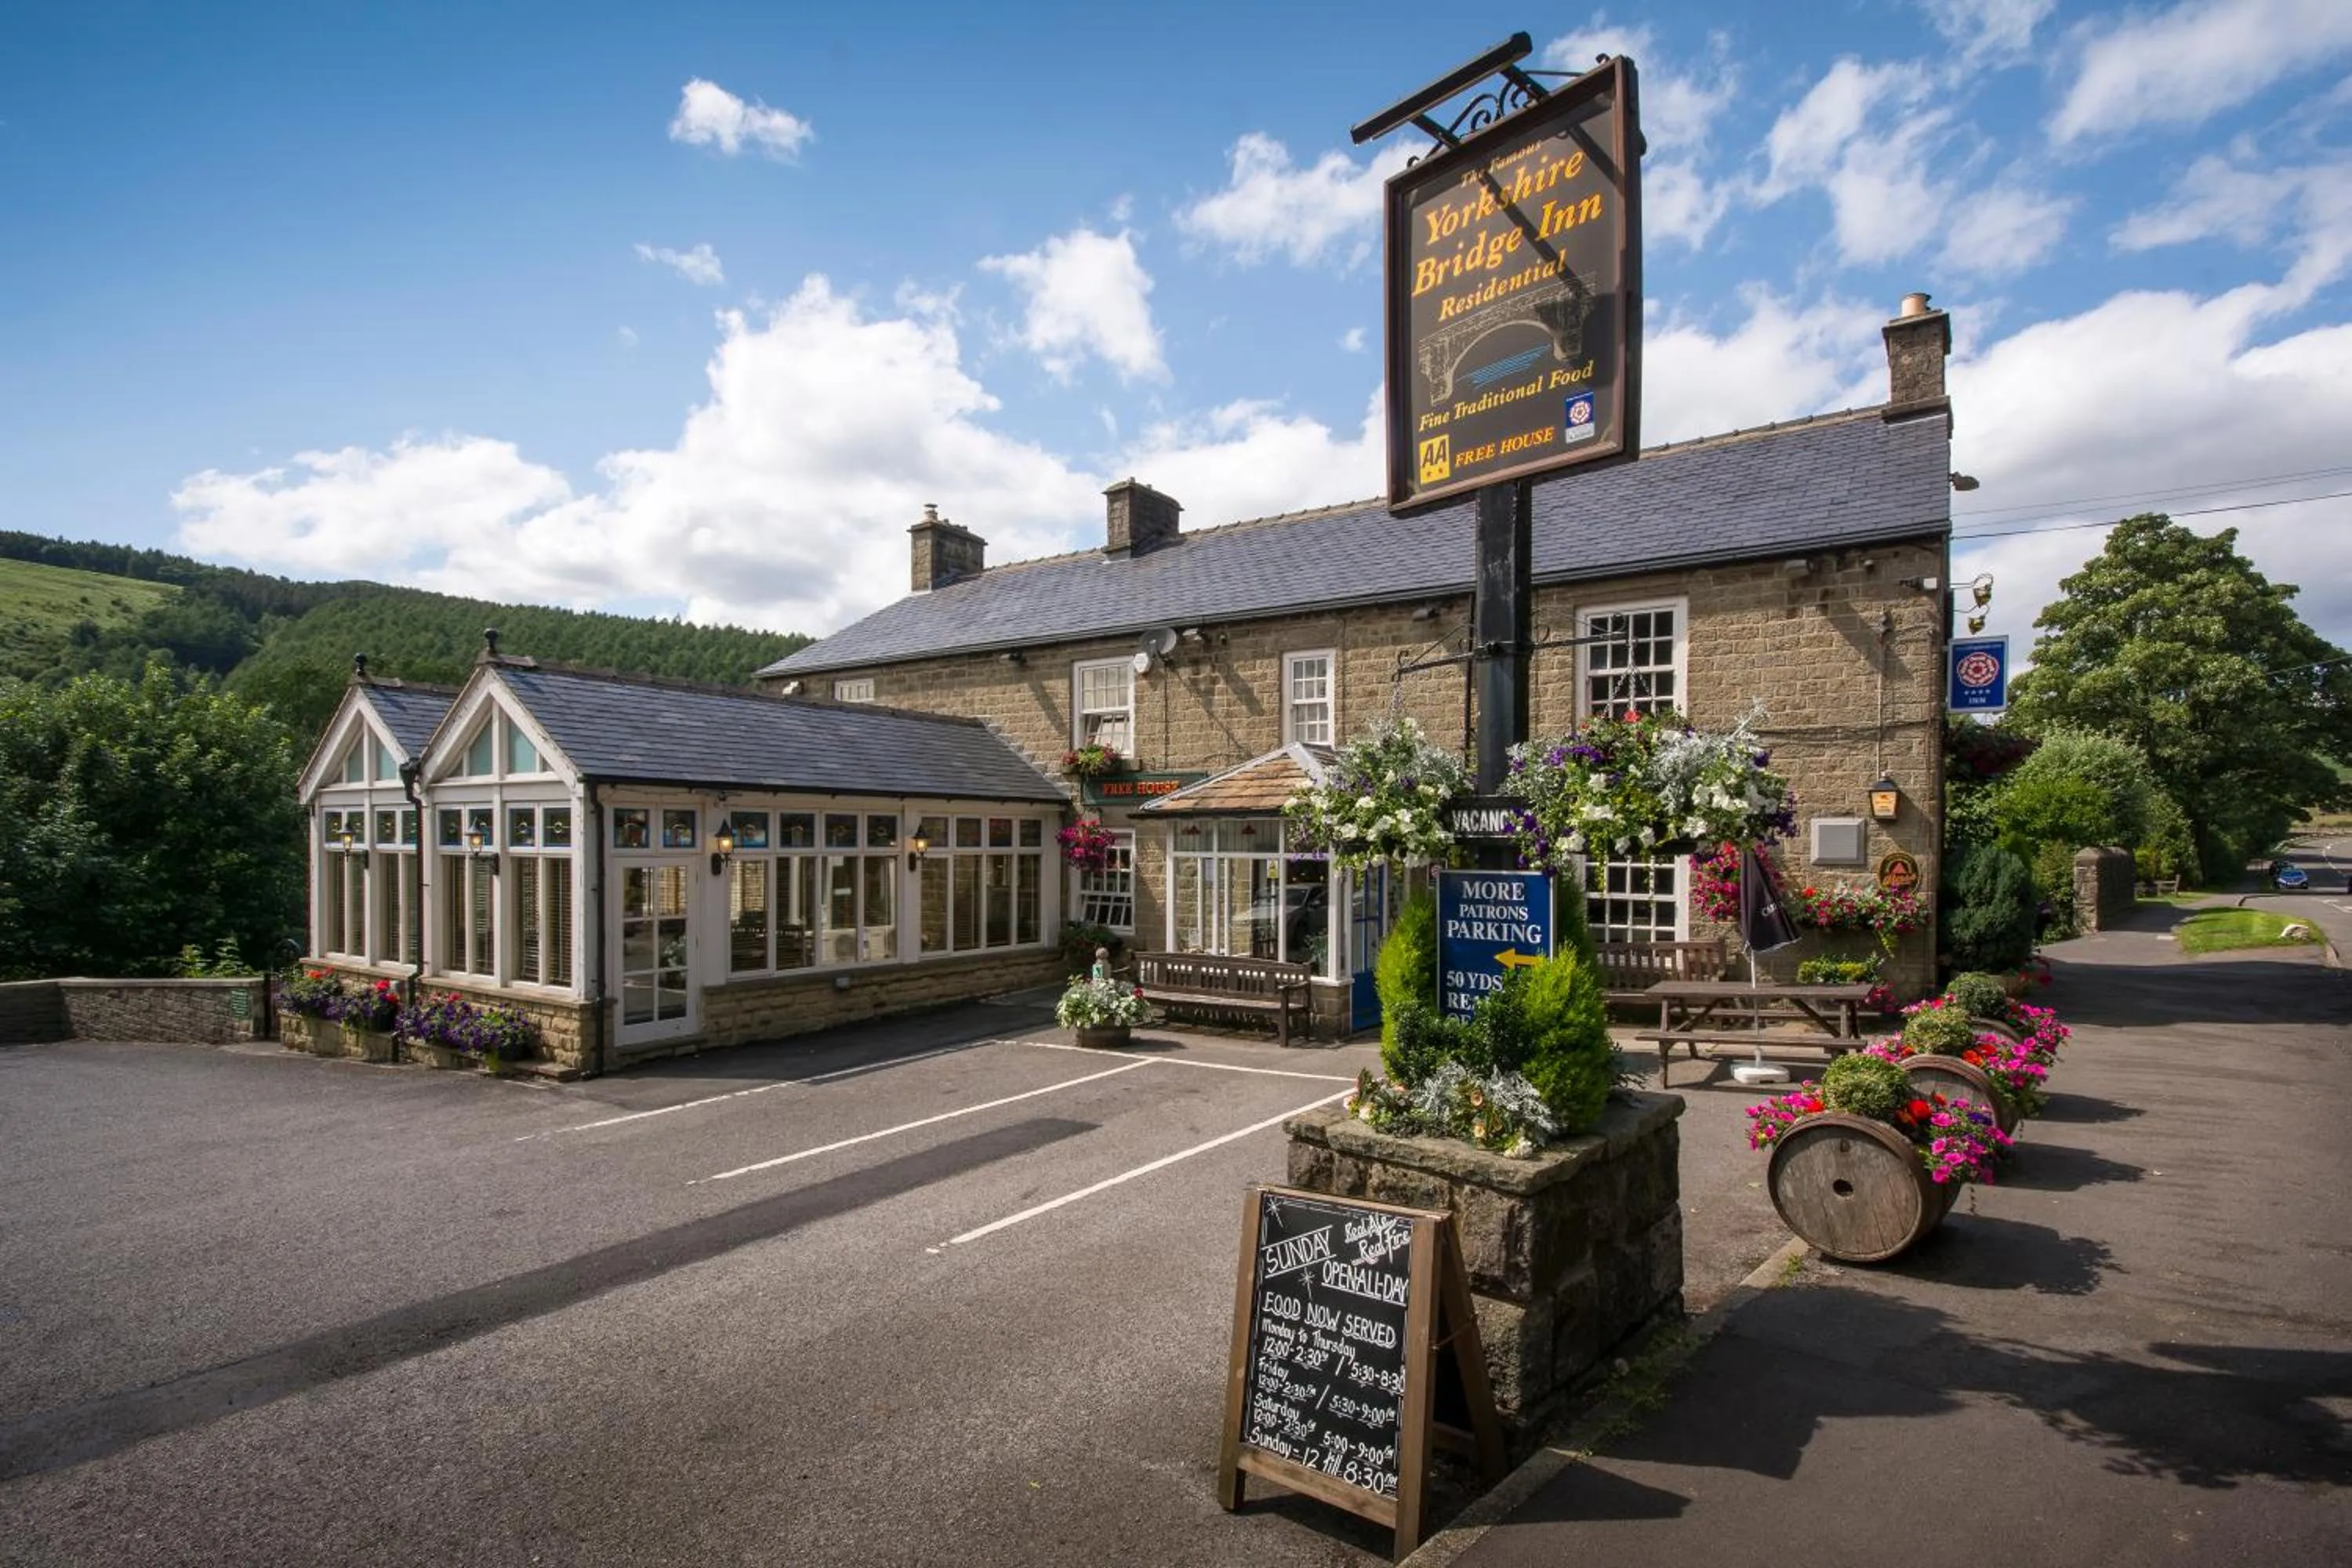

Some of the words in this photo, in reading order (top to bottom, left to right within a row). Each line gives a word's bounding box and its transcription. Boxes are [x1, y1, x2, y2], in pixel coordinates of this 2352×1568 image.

[1425, 150, 1584, 246] Yorkshire
[1411, 226, 1523, 297] Bridge
[1534, 193, 1602, 241] Inn
[1440, 248, 1567, 321] Residential
[1419, 412, 1450, 432] Fine
[1455, 376, 1544, 421] Traditional
[1548, 360, 1594, 390] Food
[1422, 438, 1447, 468] AA
[1455, 442, 1496, 468] FREE
[1501, 426, 1555, 455] HOUSE
[1103, 782, 1134, 797] FREE
[1452, 809, 1533, 832] VACANC
[1462, 881, 1525, 901] MORE
[1459, 904, 1529, 921] PATRONS
[1446, 920, 1542, 945] PARKING
[1446, 970, 1465, 988] 50
[1467, 971, 1504, 992] YDS
[1265, 1229, 1331, 1275] SUNDAY
[1264, 1291, 1301, 1316] FOOD
[1306, 1302, 1341, 1331] NOW
[1343, 1313, 1396, 1346] SERVED
[1261, 1318, 1295, 1345] Monday
[1298, 1327, 1308, 1344] to
[1312, 1330, 1356, 1365] Thursday
[1258, 1356, 1290, 1382] Friday
[1254, 1392, 1300, 1421] Saturday
[1249, 1426, 1292, 1459] Sunday
[1302, 1446, 1320, 1469] 12
